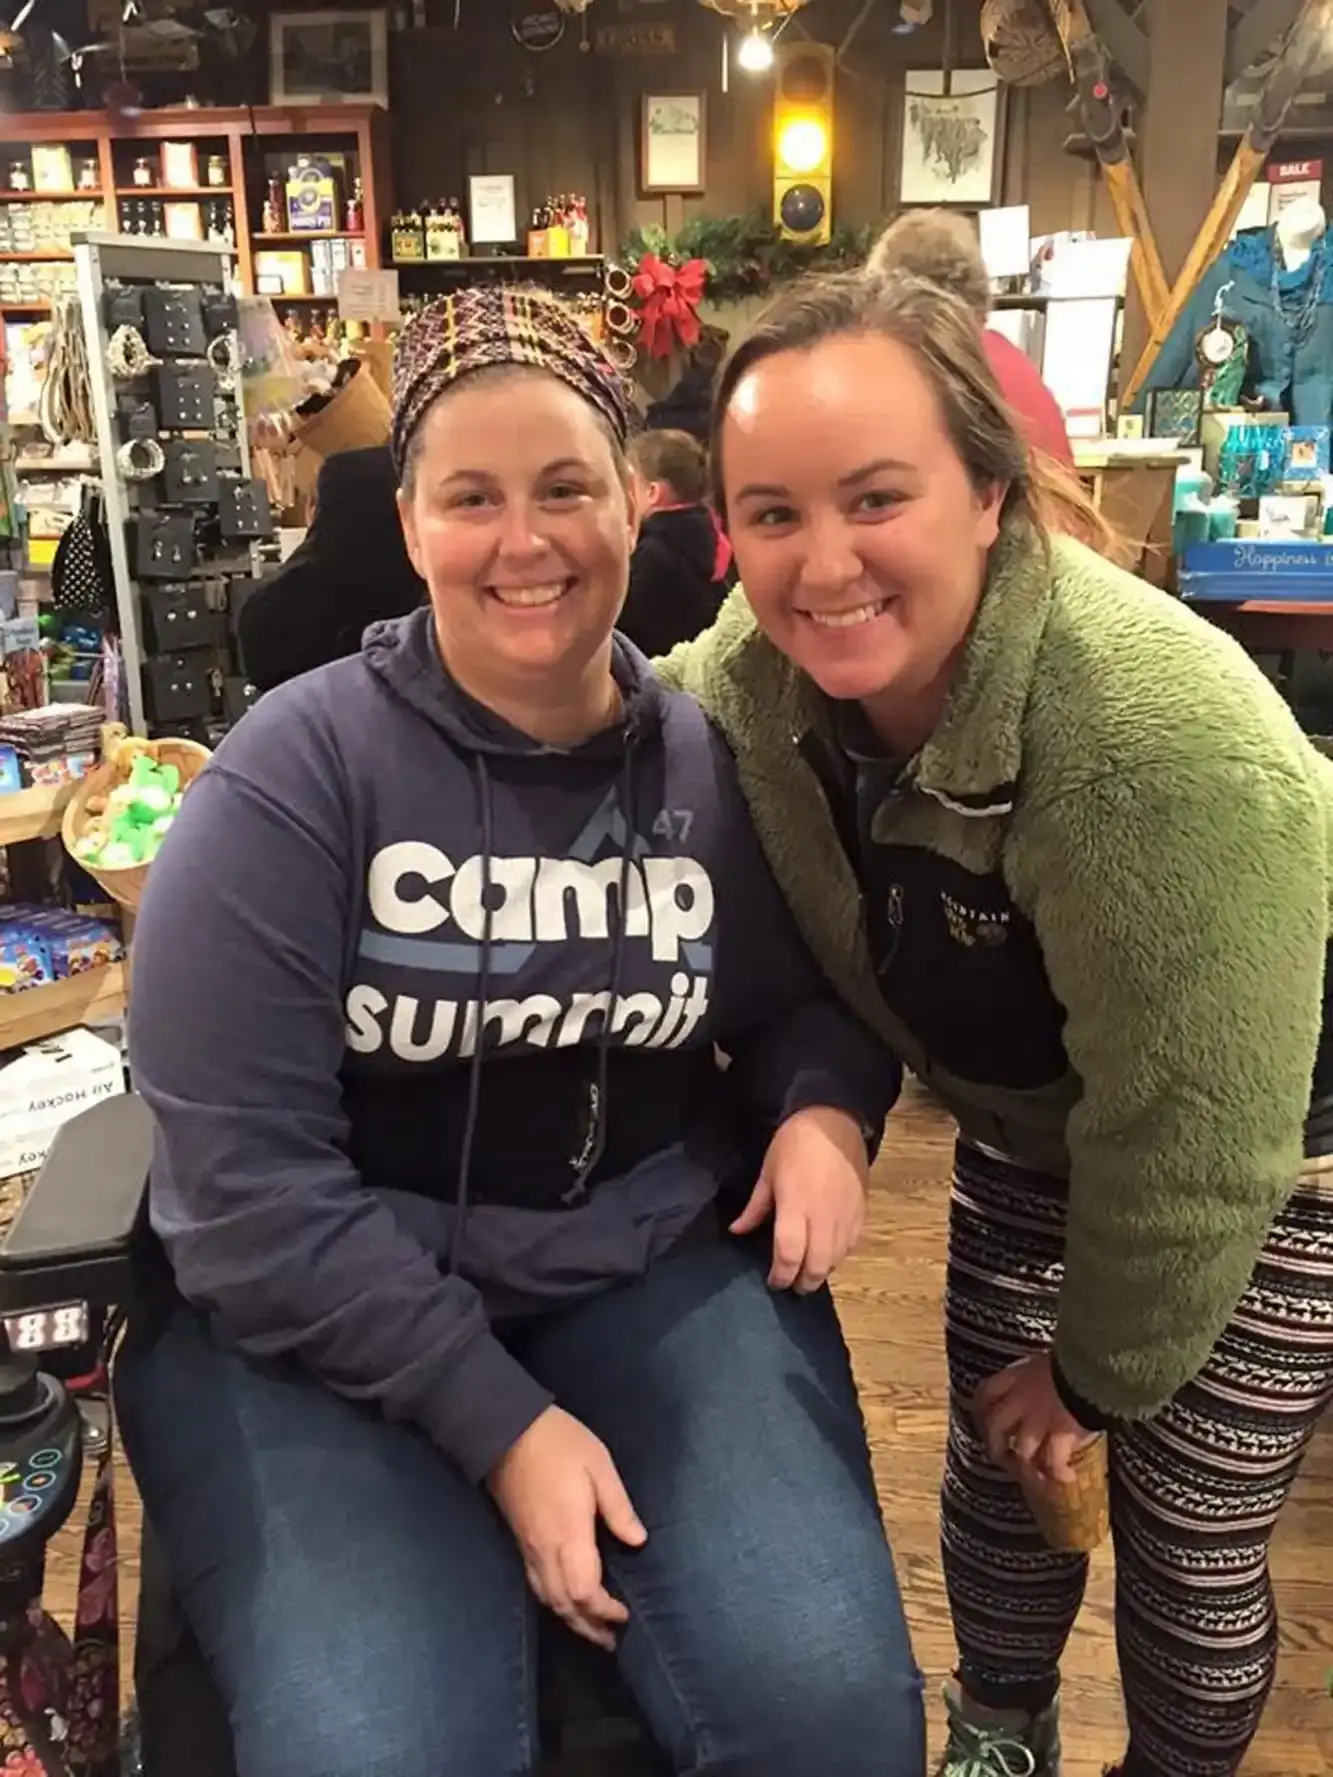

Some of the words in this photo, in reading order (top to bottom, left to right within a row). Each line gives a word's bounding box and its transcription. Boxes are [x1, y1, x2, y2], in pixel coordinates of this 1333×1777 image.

[1279, 162, 1312, 177] SALE
[1233, 544, 1317, 572] Happiness
[652, 809, 695, 844] 47
[368, 840, 715, 962] camp
[345, 972, 709, 1062] summit
[28, 1088, 87, 1114] Hockey
[91, 1080, 114, 1098] Air
